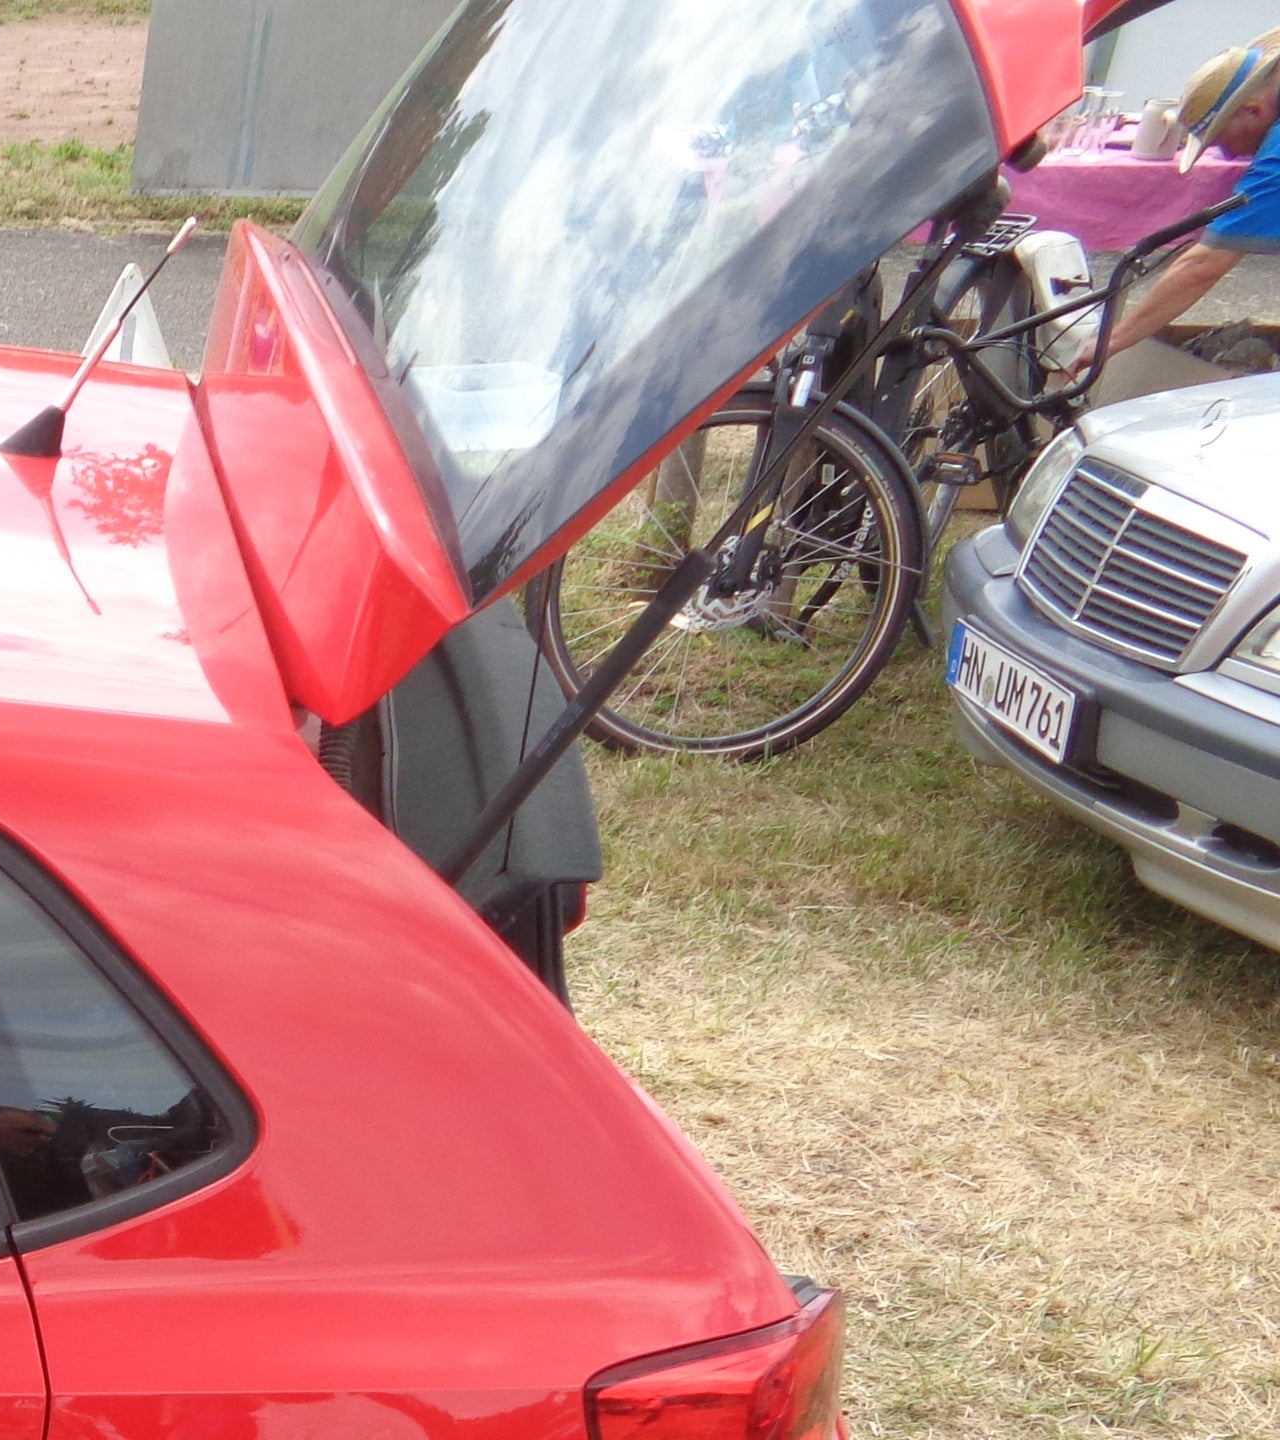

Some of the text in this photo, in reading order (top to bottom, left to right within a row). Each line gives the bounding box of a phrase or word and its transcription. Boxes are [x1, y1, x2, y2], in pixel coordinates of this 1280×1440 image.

[958, 637, 1066, 751] HN UM 761
